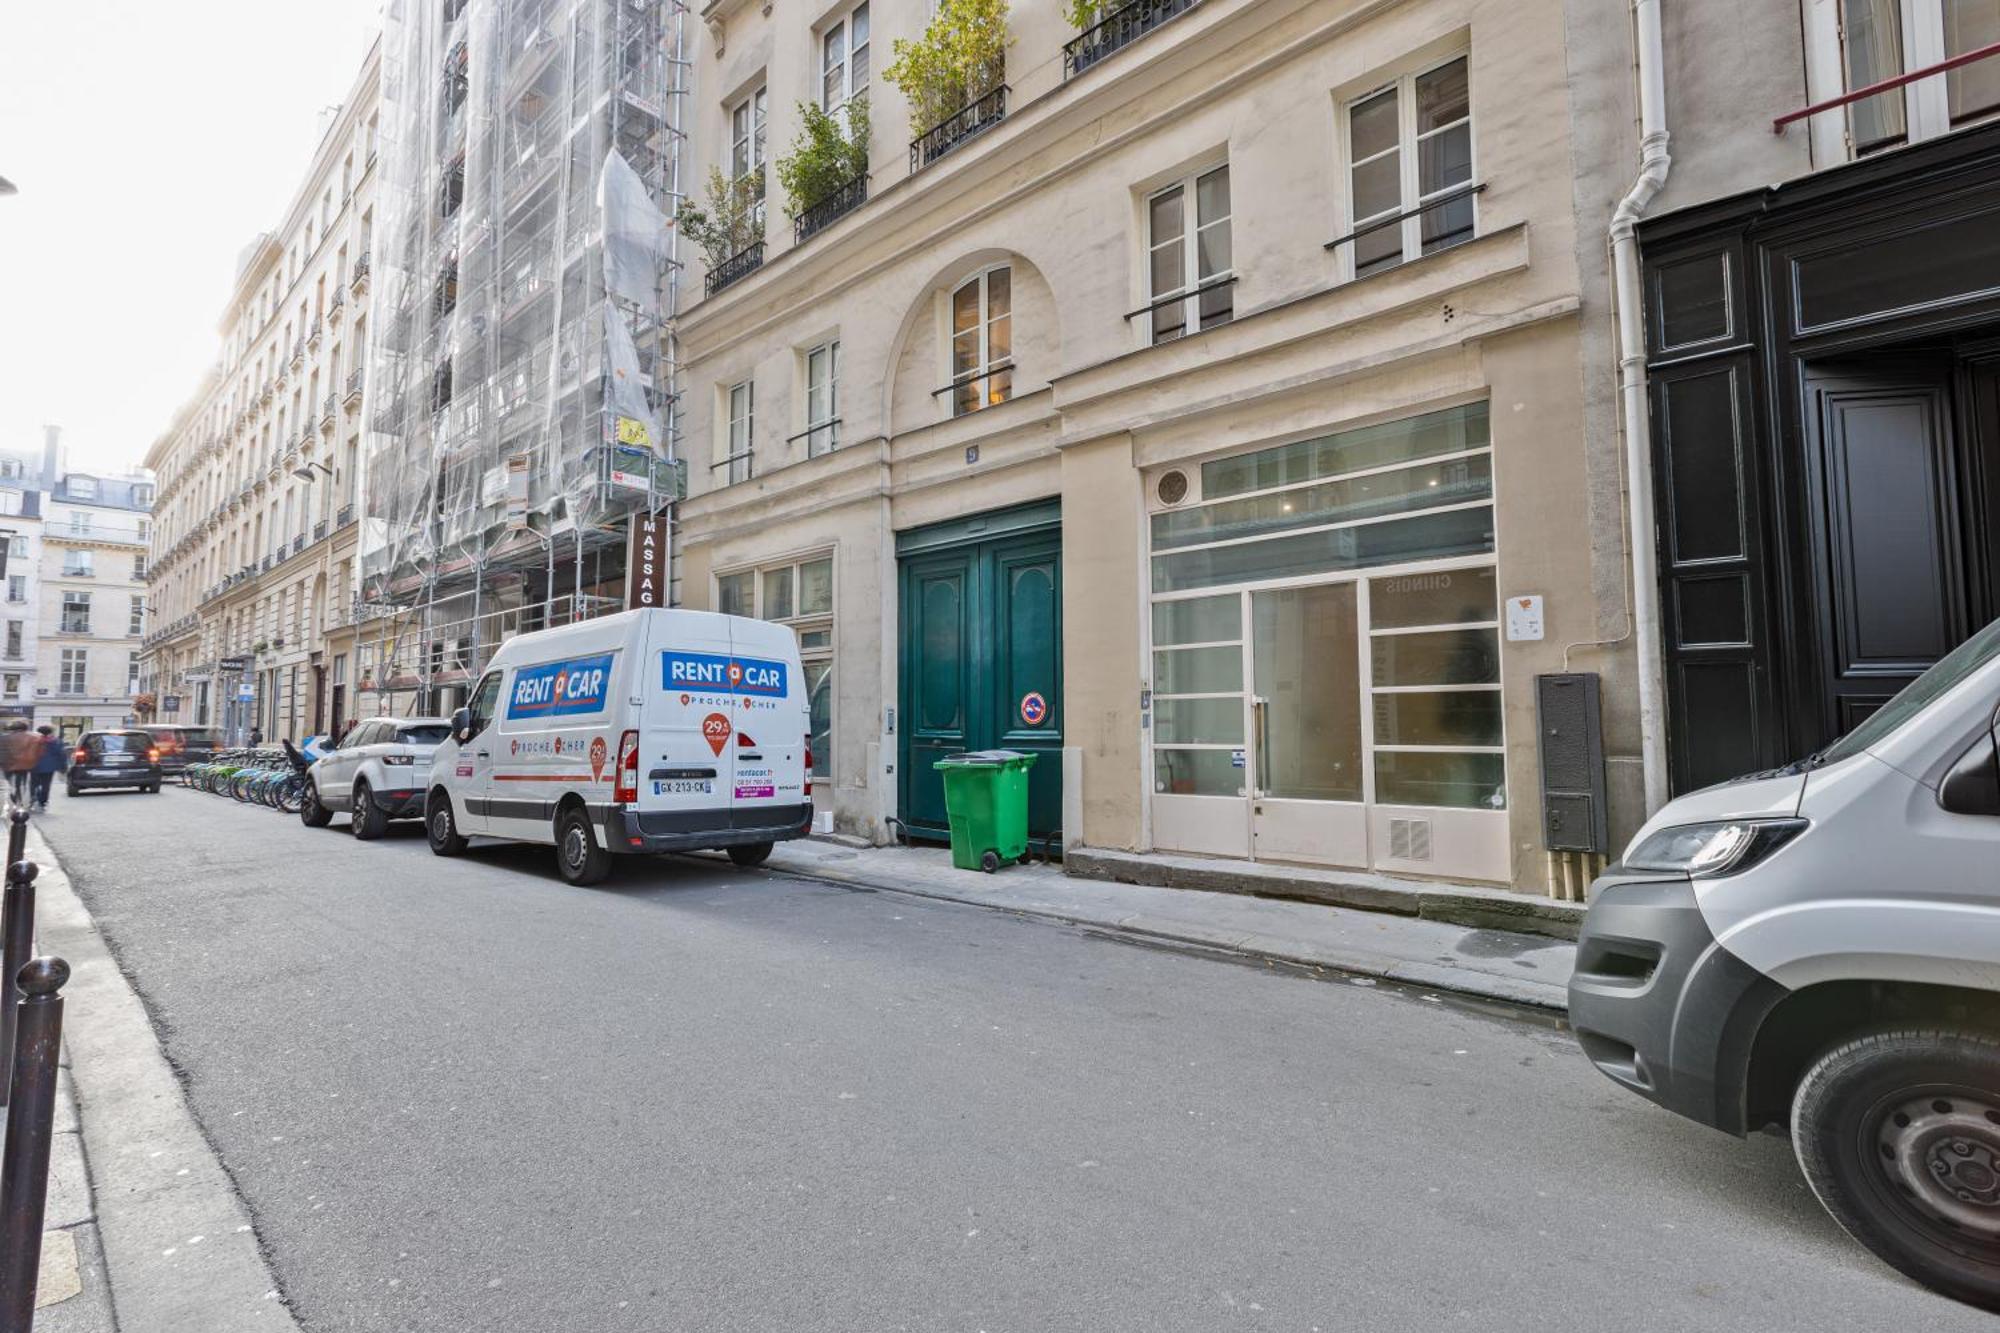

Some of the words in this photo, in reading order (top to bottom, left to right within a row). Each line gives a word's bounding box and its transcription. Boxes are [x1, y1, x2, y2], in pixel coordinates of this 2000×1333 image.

[641, 521, 656, 608] MASSAG
[515, 676, 554, 704] RENT
[567, 669, 602, 698] CAR
[671, 661, 724, 682] RENT
[745, 668, 780, 687] CAR
